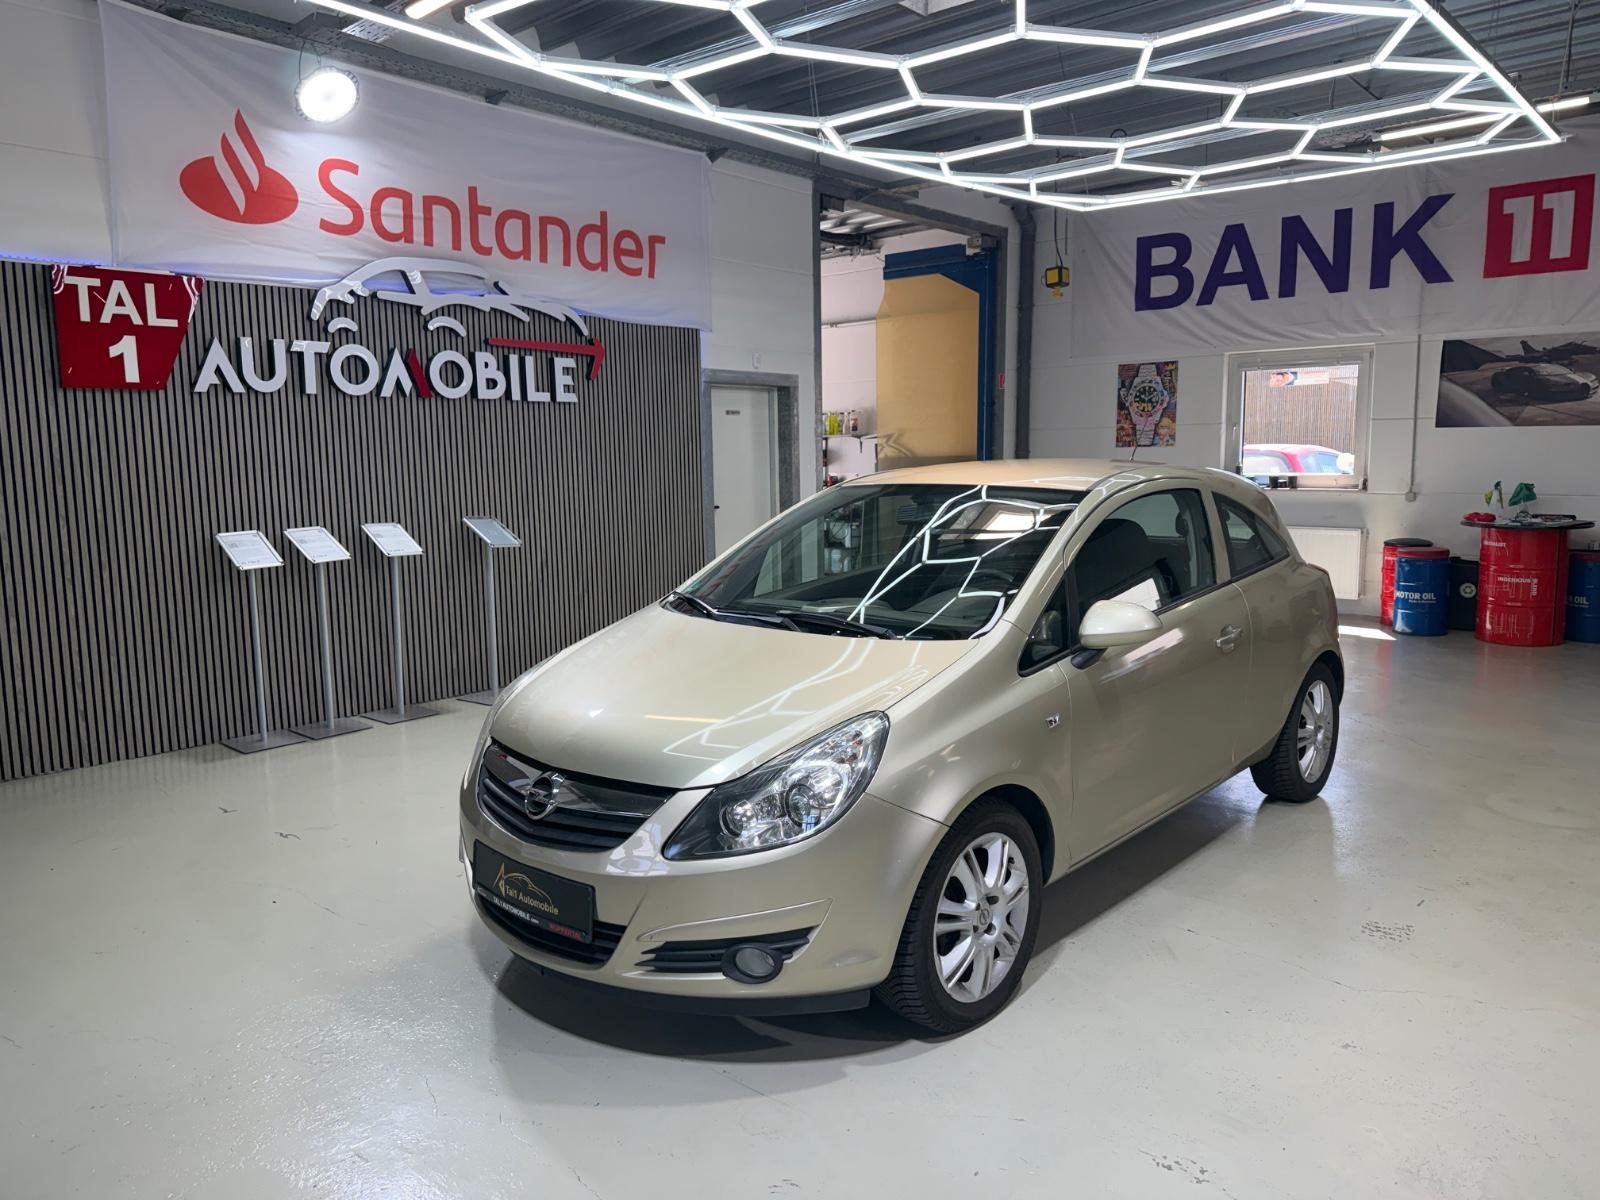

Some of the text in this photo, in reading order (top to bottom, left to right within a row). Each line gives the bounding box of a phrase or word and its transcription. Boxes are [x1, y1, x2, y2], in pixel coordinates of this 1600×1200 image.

[317, 157, 666, 279] Santander
[1134, 190, 1575, 312] BANK 11
[64, 275, 179, 328] TAL
[108, 334, 141, 384] 1
[192, 336, 579, 404] AUTOMOBILE
[1422, 592, 1437, 600] OIL
[518, 891, 559, 915] Automobile
